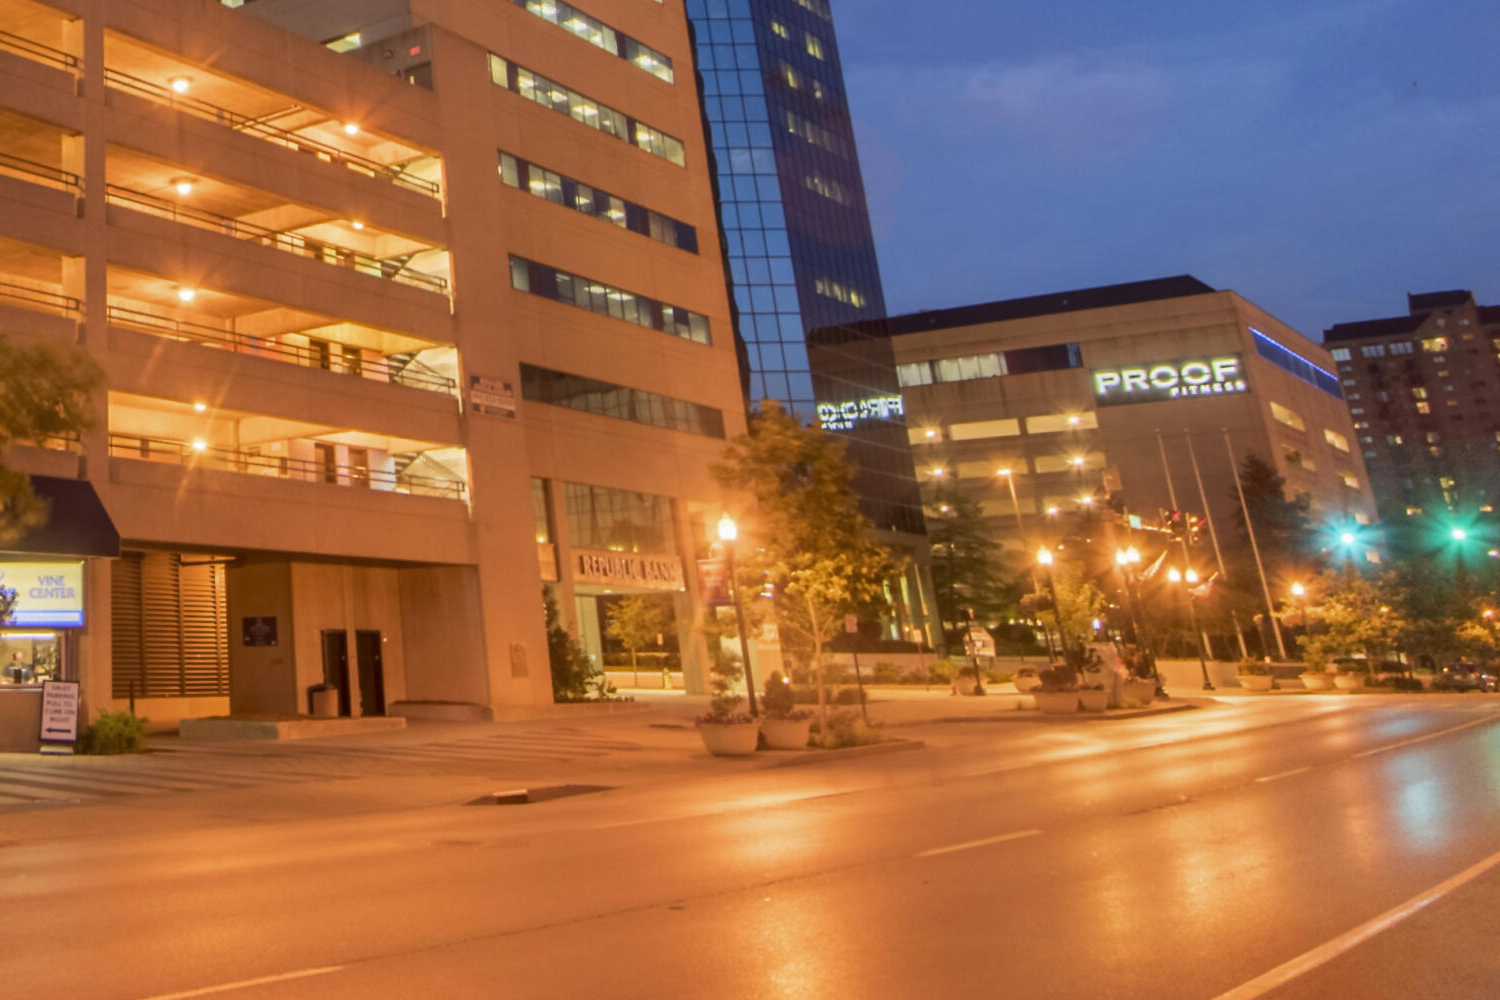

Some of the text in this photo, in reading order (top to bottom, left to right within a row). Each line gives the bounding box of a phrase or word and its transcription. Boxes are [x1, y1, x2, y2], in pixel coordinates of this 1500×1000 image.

[1093, 357, 1239, 396] PROOF
[1170, 379, 1247, 398] FITNESS
[579, 555, 638, 580] REPUBLIC
[37, 575, 66, 586] VINE
[28, 587, 76, 599] CENTER
